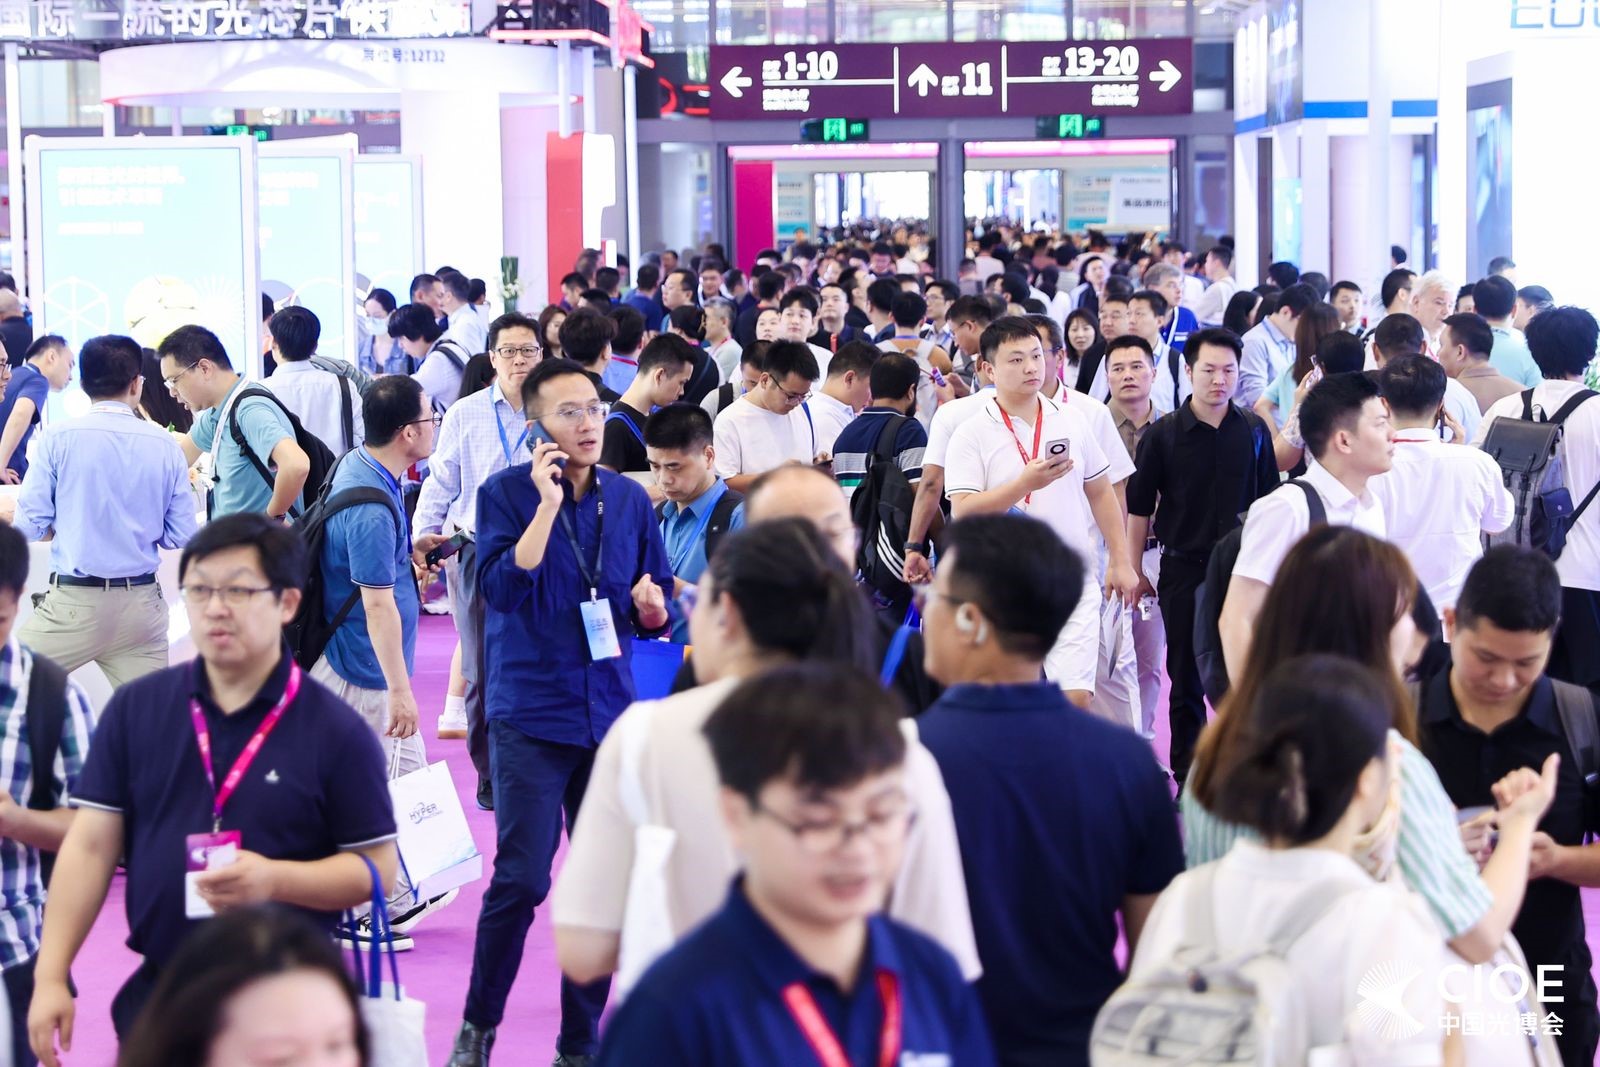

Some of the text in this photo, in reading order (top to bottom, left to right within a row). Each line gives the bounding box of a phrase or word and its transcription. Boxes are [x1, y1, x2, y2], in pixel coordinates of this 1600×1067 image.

[784, 50, 838, 80] 1-10
[1065, 46, 1139, 76] 13-20
[961, 62, 993, 95] 11
[409, 803, 438, 821] HYPER
